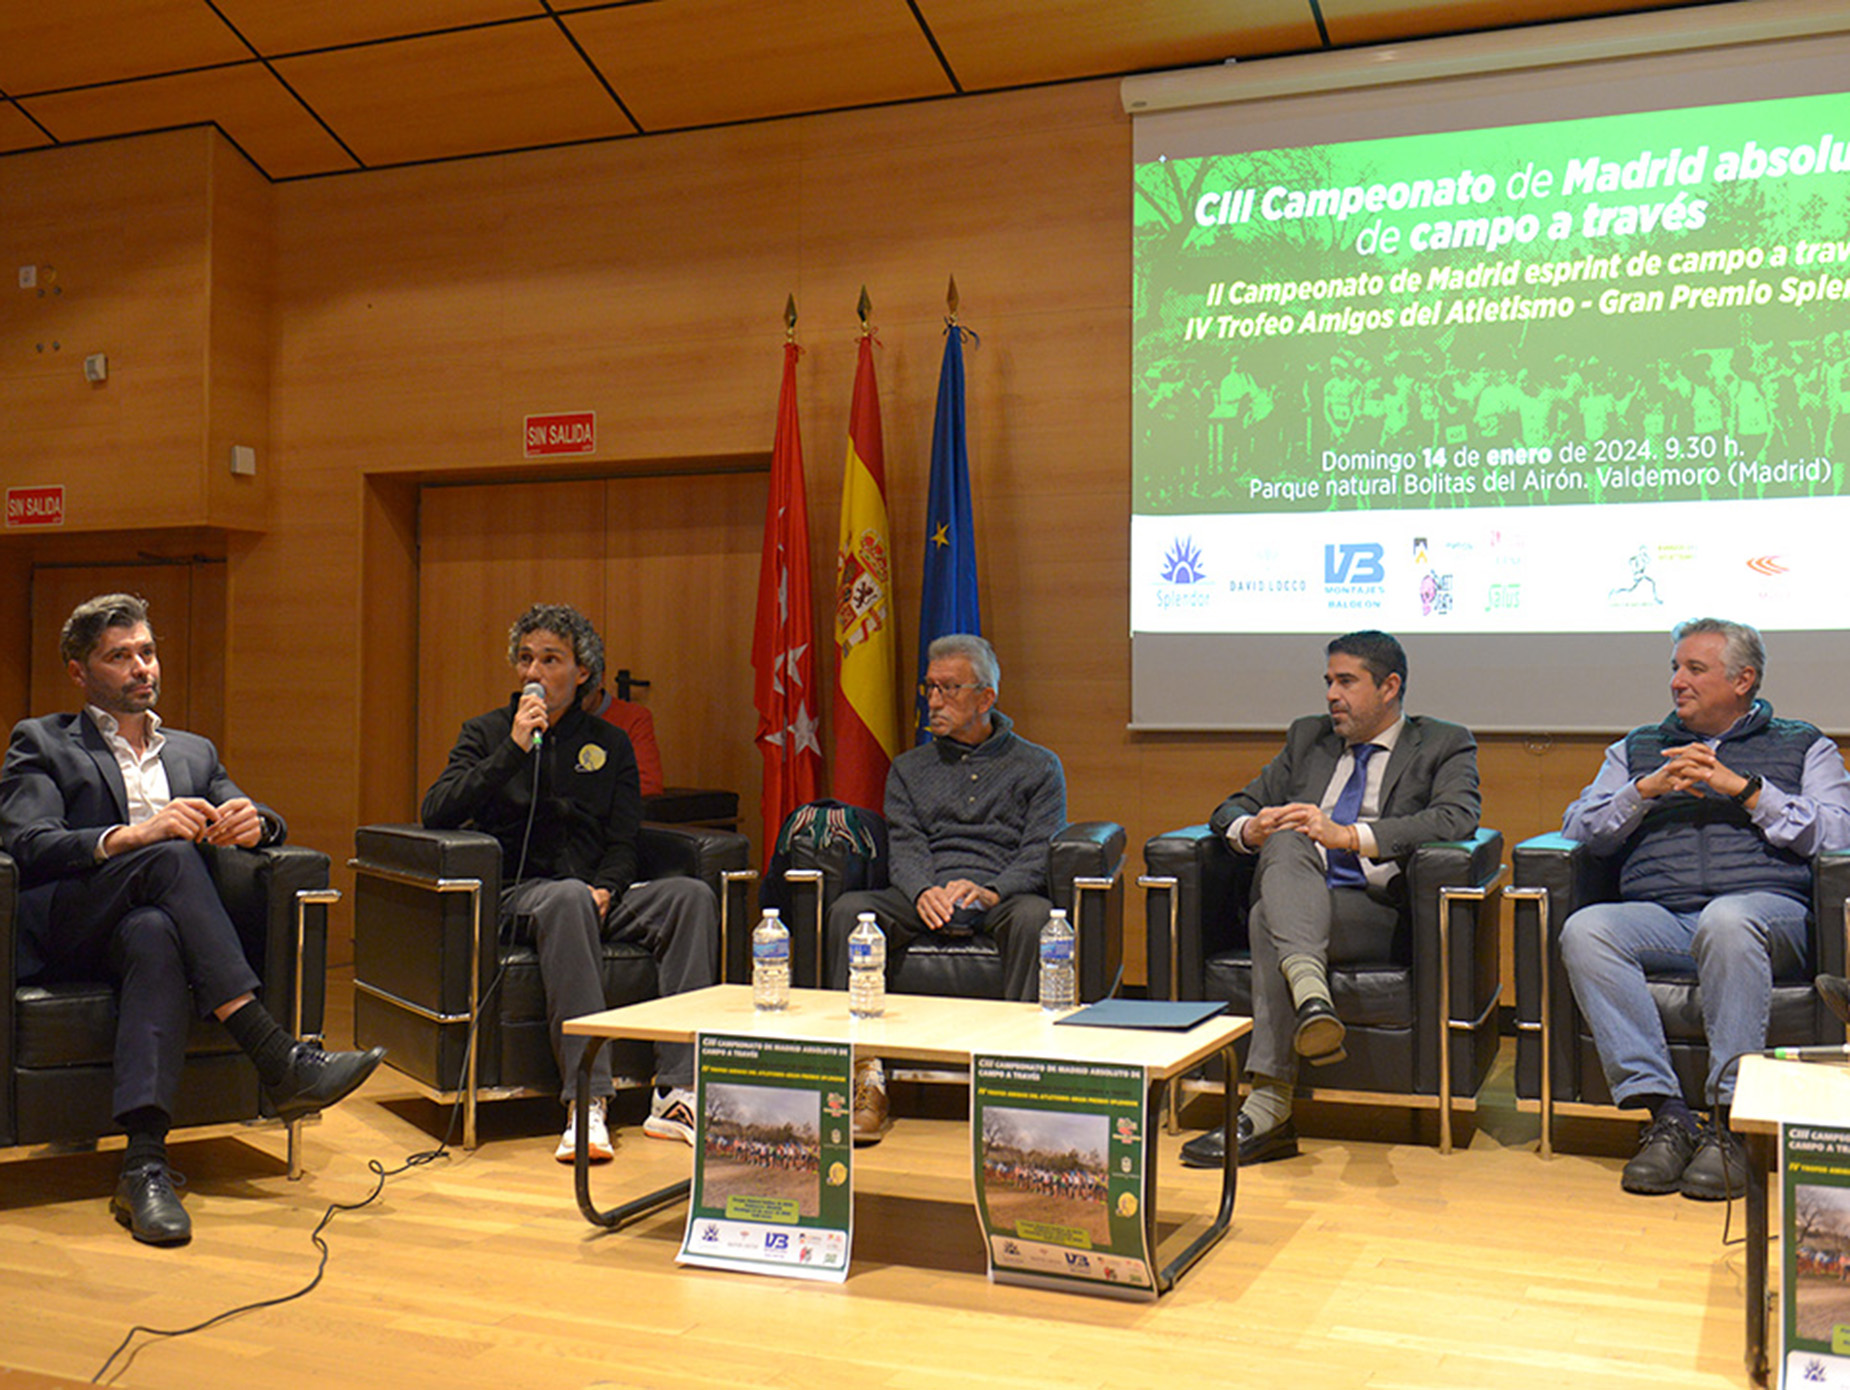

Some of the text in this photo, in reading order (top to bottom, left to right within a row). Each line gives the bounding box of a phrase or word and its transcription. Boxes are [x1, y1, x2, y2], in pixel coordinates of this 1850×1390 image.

[1195, 134, 1850, 226] CIII Campeonato de Madrid absolu
[1356, 191, 1709, 255] de campo a través
[1206, 239, 1850, 306] II Campeonato de Madrid esprint de campo a trav
[1184, 316, 1214, 341] IV
[1216, 312, 1294, 339] Trofeo
[1298, 306, 1394, 335] Amigos
[1399, 300, 1442, 327] del
[1444, 294, 1575, 324] Atletismo
[1598, 289, 1664, 315] Gran
[1669, 278, 1772, 310] Premio
[528, 423, 592, 446] SIN SALIDA
[1322, 434, 1745, 473] Domingo 14 de enero de 2024. 9.30 h.
[1250, 457, 1832, 501] Parque natural Bolitas del Airón. Valdemoro (Madrid)
[8, 497, 62, 517] SIN SALIDA
[1230, 580, 1306, 591] DAVID LOCCO
[1324, 586, 1385, 595] MONTAJES
